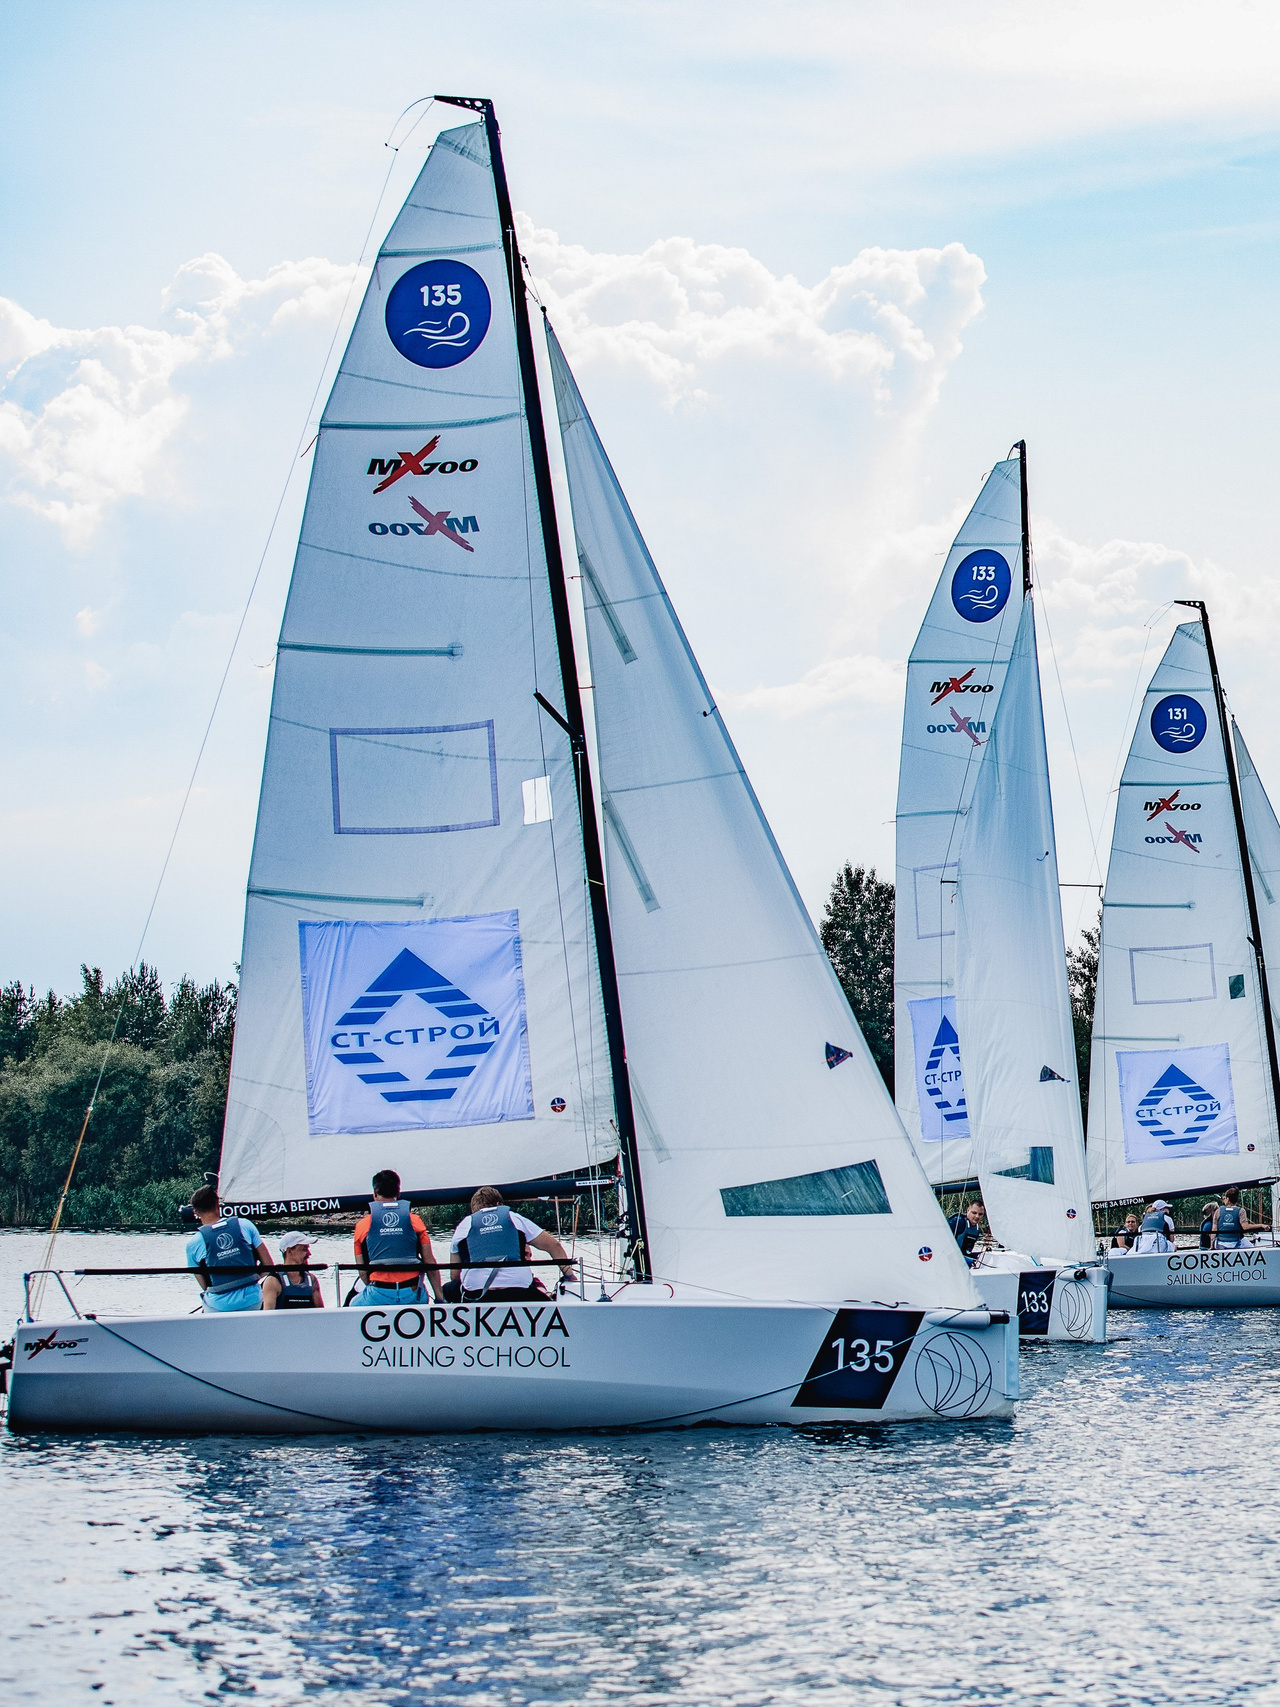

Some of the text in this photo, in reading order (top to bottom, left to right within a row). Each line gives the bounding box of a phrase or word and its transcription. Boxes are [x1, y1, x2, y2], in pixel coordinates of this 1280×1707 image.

[420, 284, 462, 306] 135
[367, 435, 479, 494] MX700
[972, 565, 996, 581] 133
[930, 667, 994, 706] MX700
[1167, 708, 1187, 720] 131
[1143, 789, 1201, 821] MX700
[331, 1017, 500, 1048] СТ-СТРОЙ
[924, 1070, 962, 1085] СТ-СТР
[1135, 1100, 1222, 1118] СТ-СТРОЙ
[270, 1202, 288, 1213] ЗА
[290, 1199, 340, 1212] ВЕТРОМ
[1091, 1202, 1108, 1210] ГОНЕ
[1167, 1250, 1267, 1271] GORSKAYA
[1167, 1269, 1267, 1286] SAILING SCHOOL
[1021, 1290, 1049, 1314] 133
[360, 1306, 570, 1342] GORSKAYA
[361, 1346, 571, 1368] SAILING SCHOOL
[831, 1337, 895, 1373] 135
